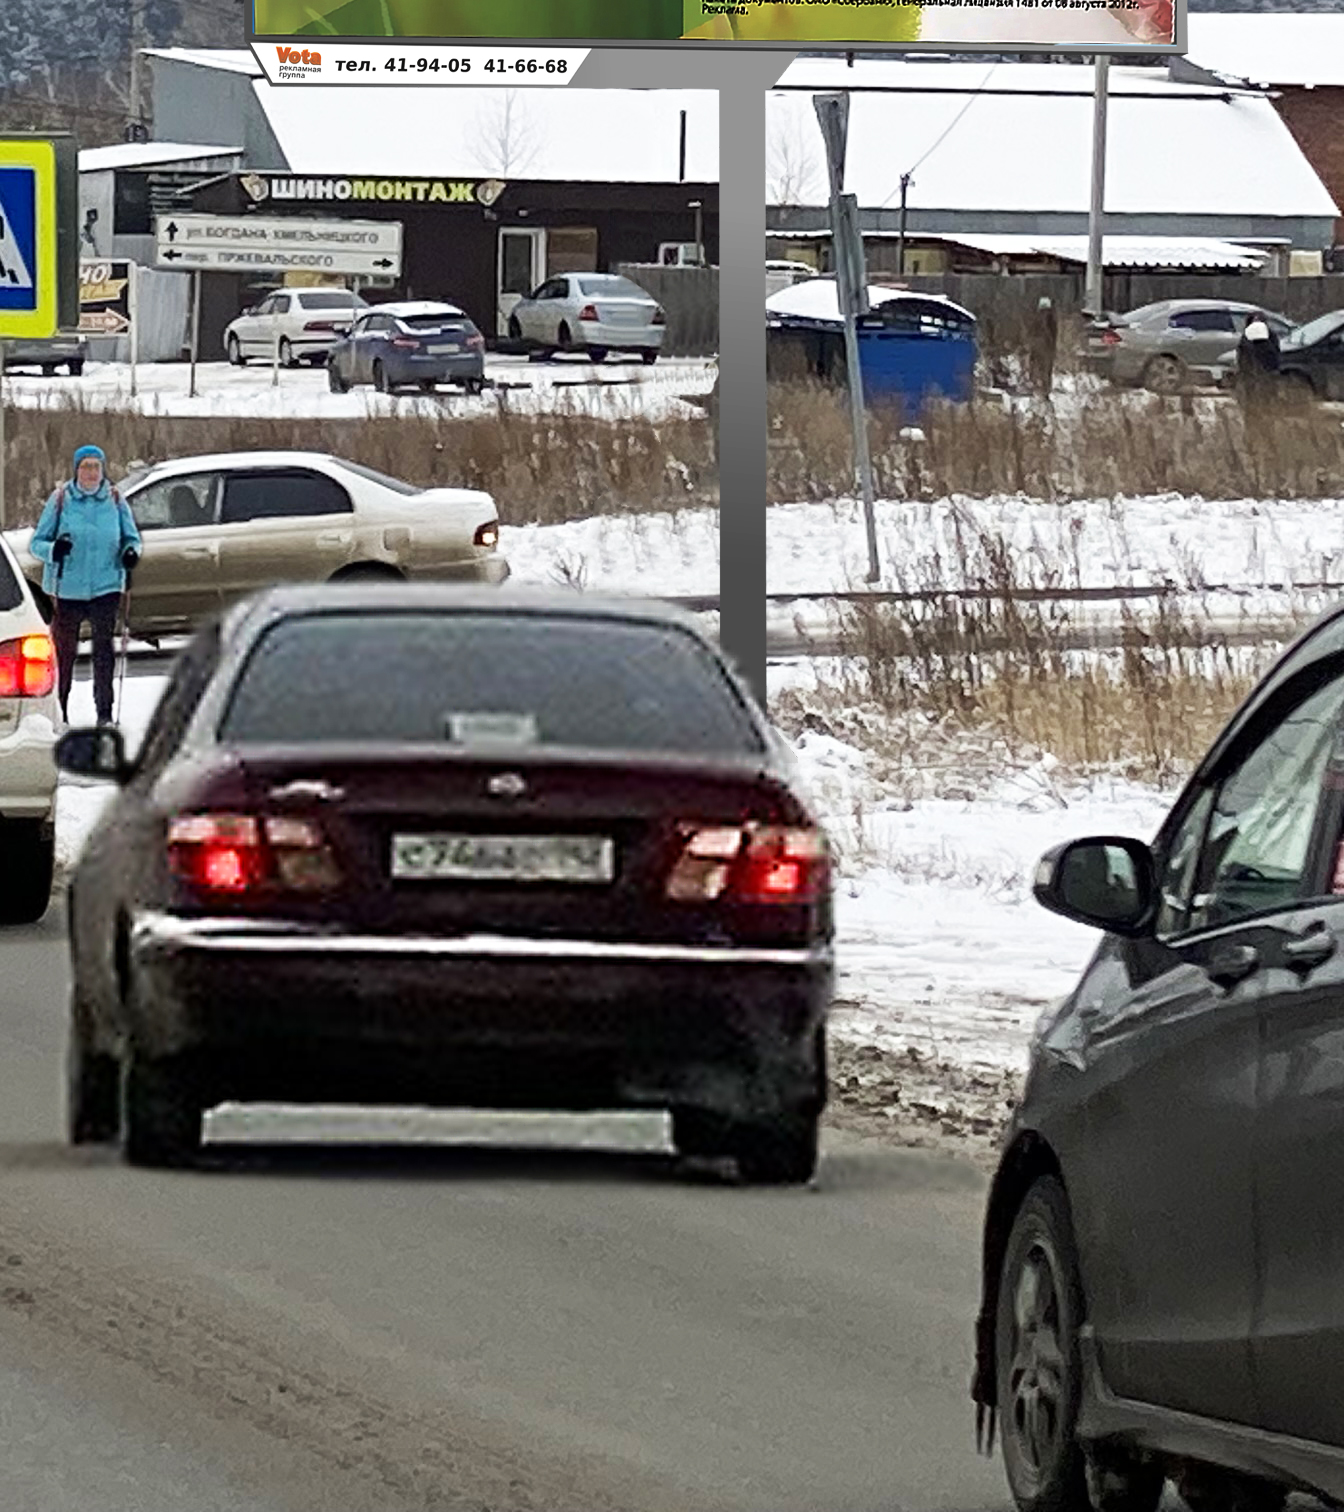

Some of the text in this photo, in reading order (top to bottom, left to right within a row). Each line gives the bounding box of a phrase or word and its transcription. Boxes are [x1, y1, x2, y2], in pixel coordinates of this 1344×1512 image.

[276, 46, 322, 66] Vota
[278, 65, 322, 73] рекламная
[335, 57, 568, 74] тел. 41-94-05 41-66-68
[271, 178, 476, 203] ШИНОМОНТАЖ
